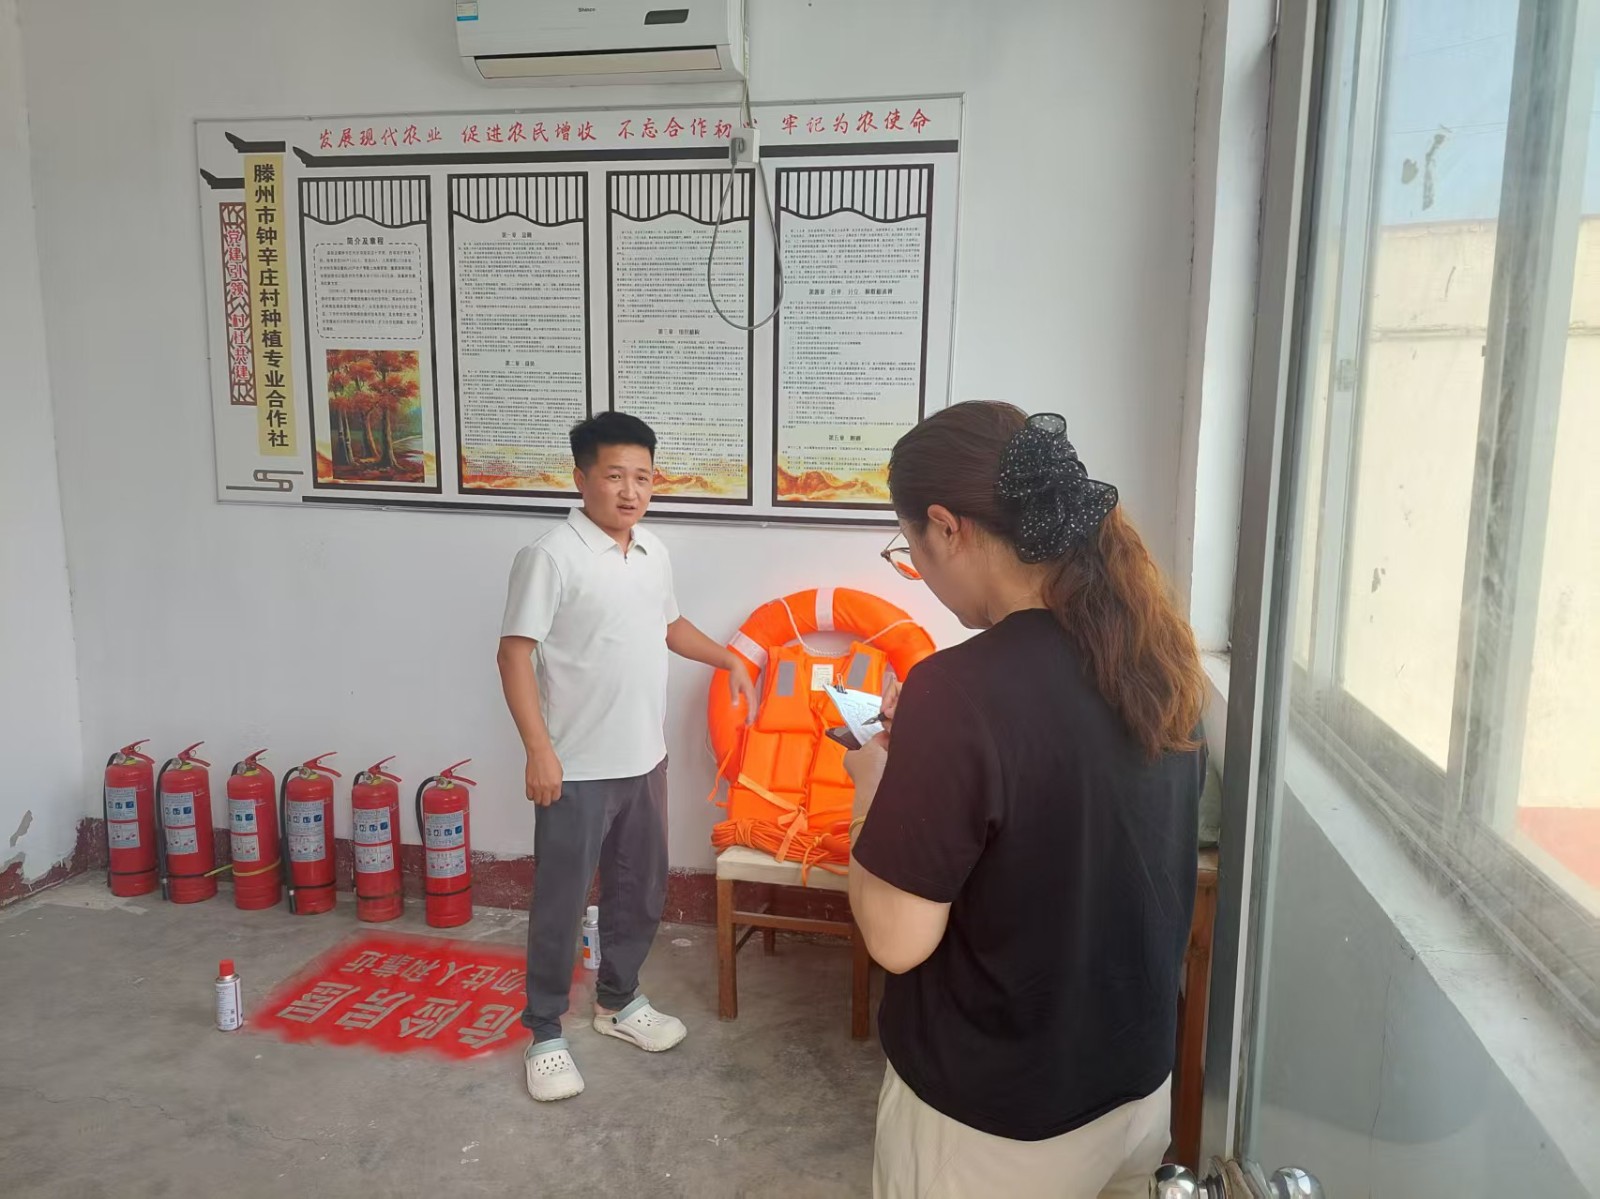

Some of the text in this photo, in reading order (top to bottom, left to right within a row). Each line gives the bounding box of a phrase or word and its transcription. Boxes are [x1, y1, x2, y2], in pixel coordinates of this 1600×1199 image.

[319, 123, 443, 149] 发展现代农业
[461, 120, 597, 144] 促进农民增收
[780, 107, 932, 135] 牢记为农使命
[226, 228, 251, 380] 党建引领 村社共建
[253, 163, 290, 448] 滕州市钟辛庄村种植专业合作社
[340, 949, 528, 996] 勿住人和靠近
[275, 981, 524, 1049] 危险房屋
